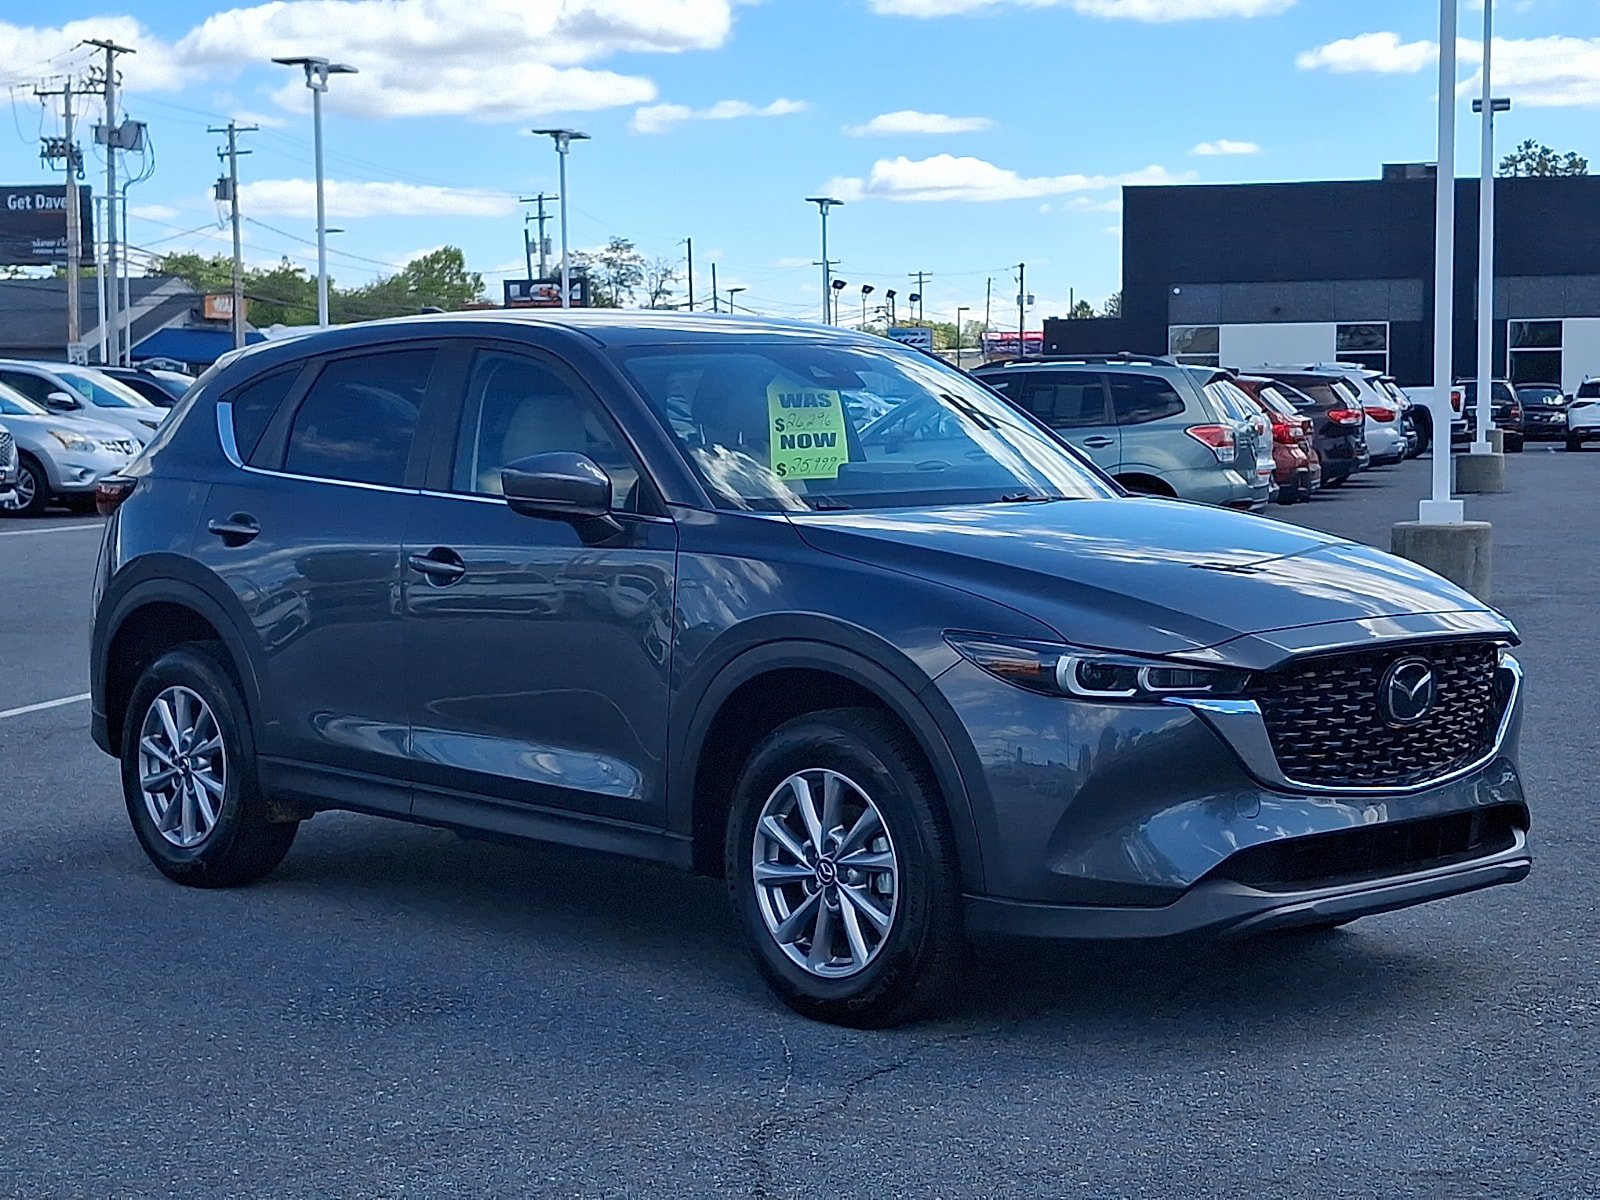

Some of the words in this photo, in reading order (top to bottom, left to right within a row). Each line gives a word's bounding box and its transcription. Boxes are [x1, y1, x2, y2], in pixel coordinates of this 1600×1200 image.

[7, 194, 32, 210] Get
[778, 392, 832, 408] WAS
[780, 432, 837, 450] NOW
